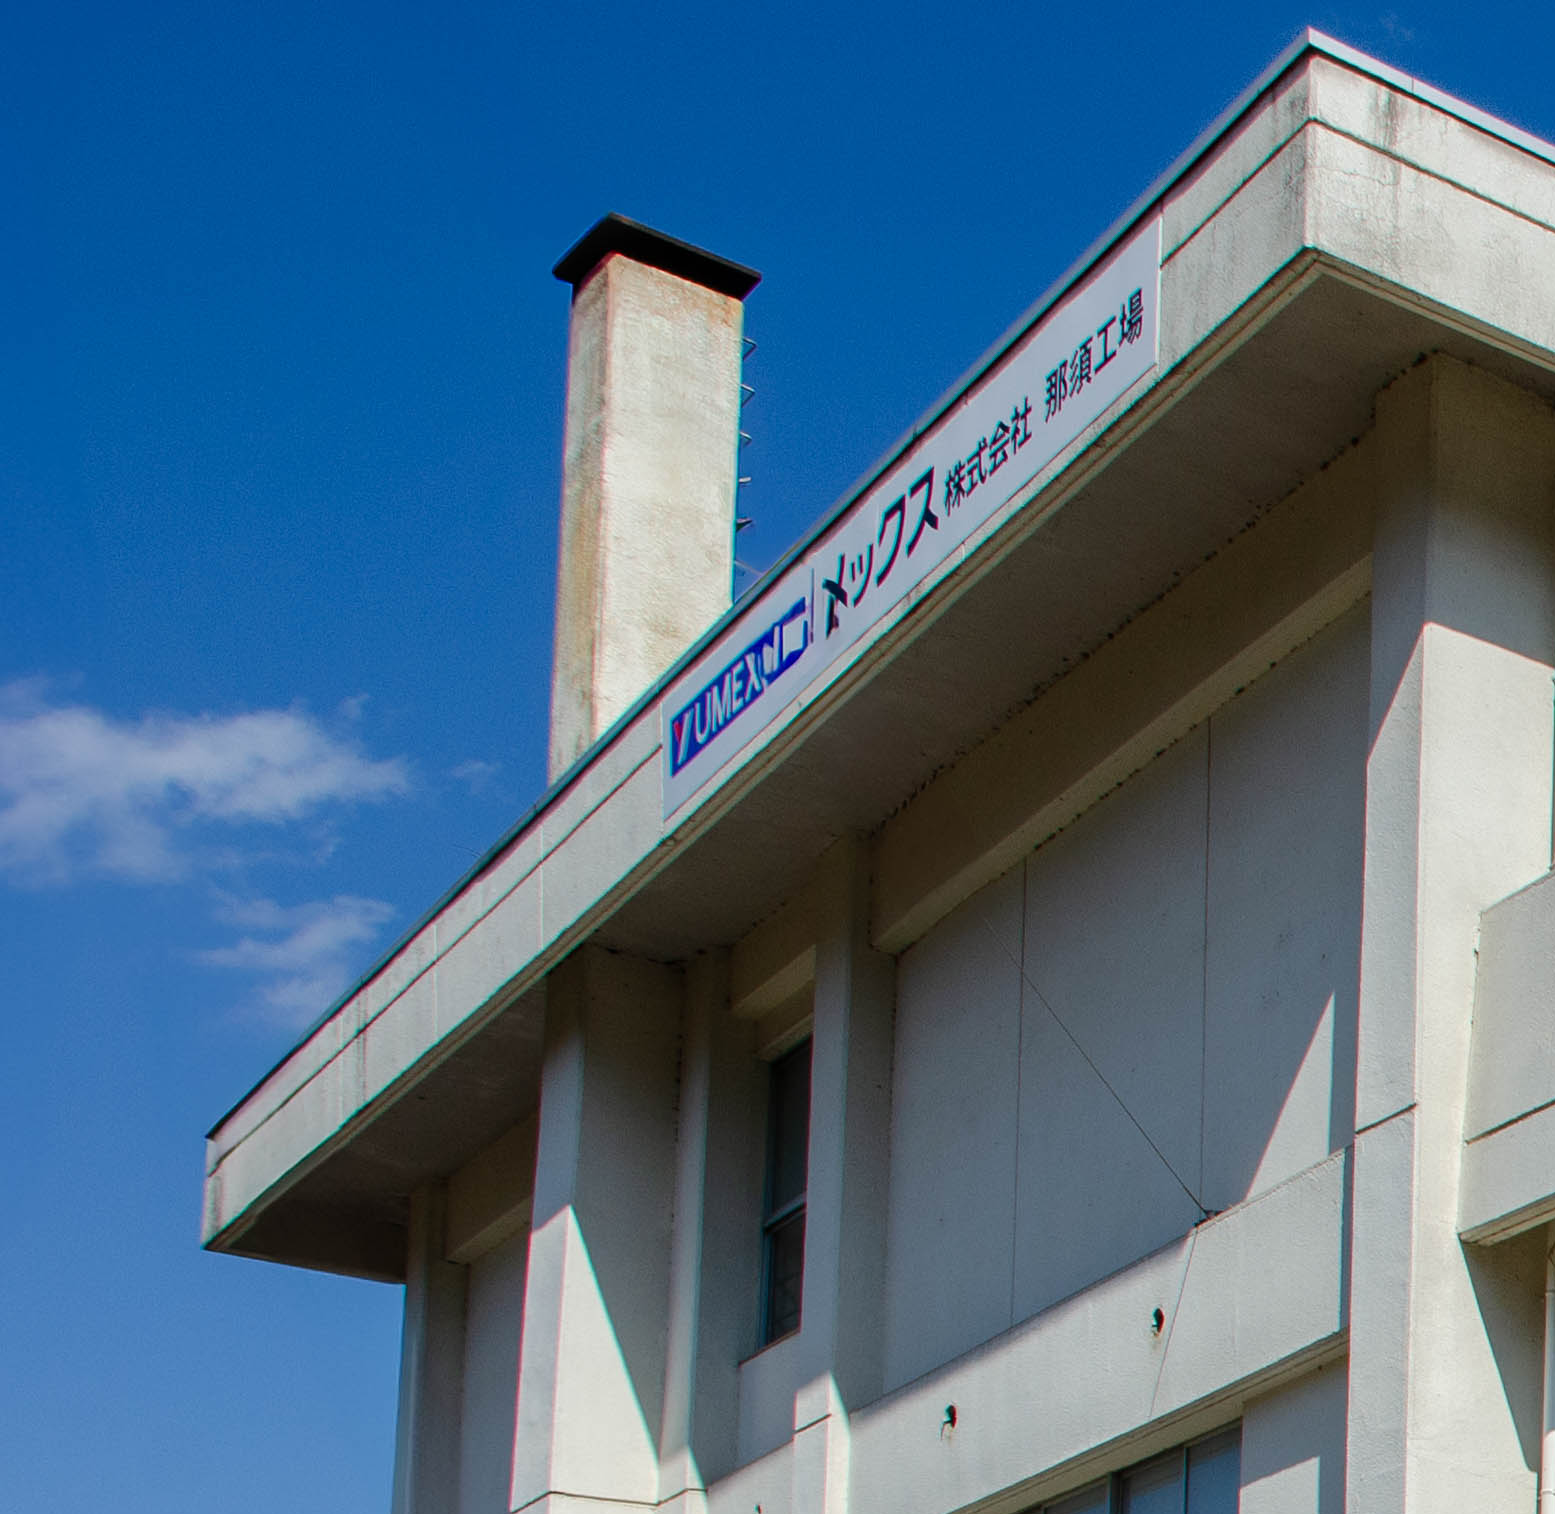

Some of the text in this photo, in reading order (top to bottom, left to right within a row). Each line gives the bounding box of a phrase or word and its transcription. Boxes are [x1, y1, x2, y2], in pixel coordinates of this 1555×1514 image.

[943, 398, 1033, 516] 株式会社
[1044, 287, 1144, 424] 那須工場
